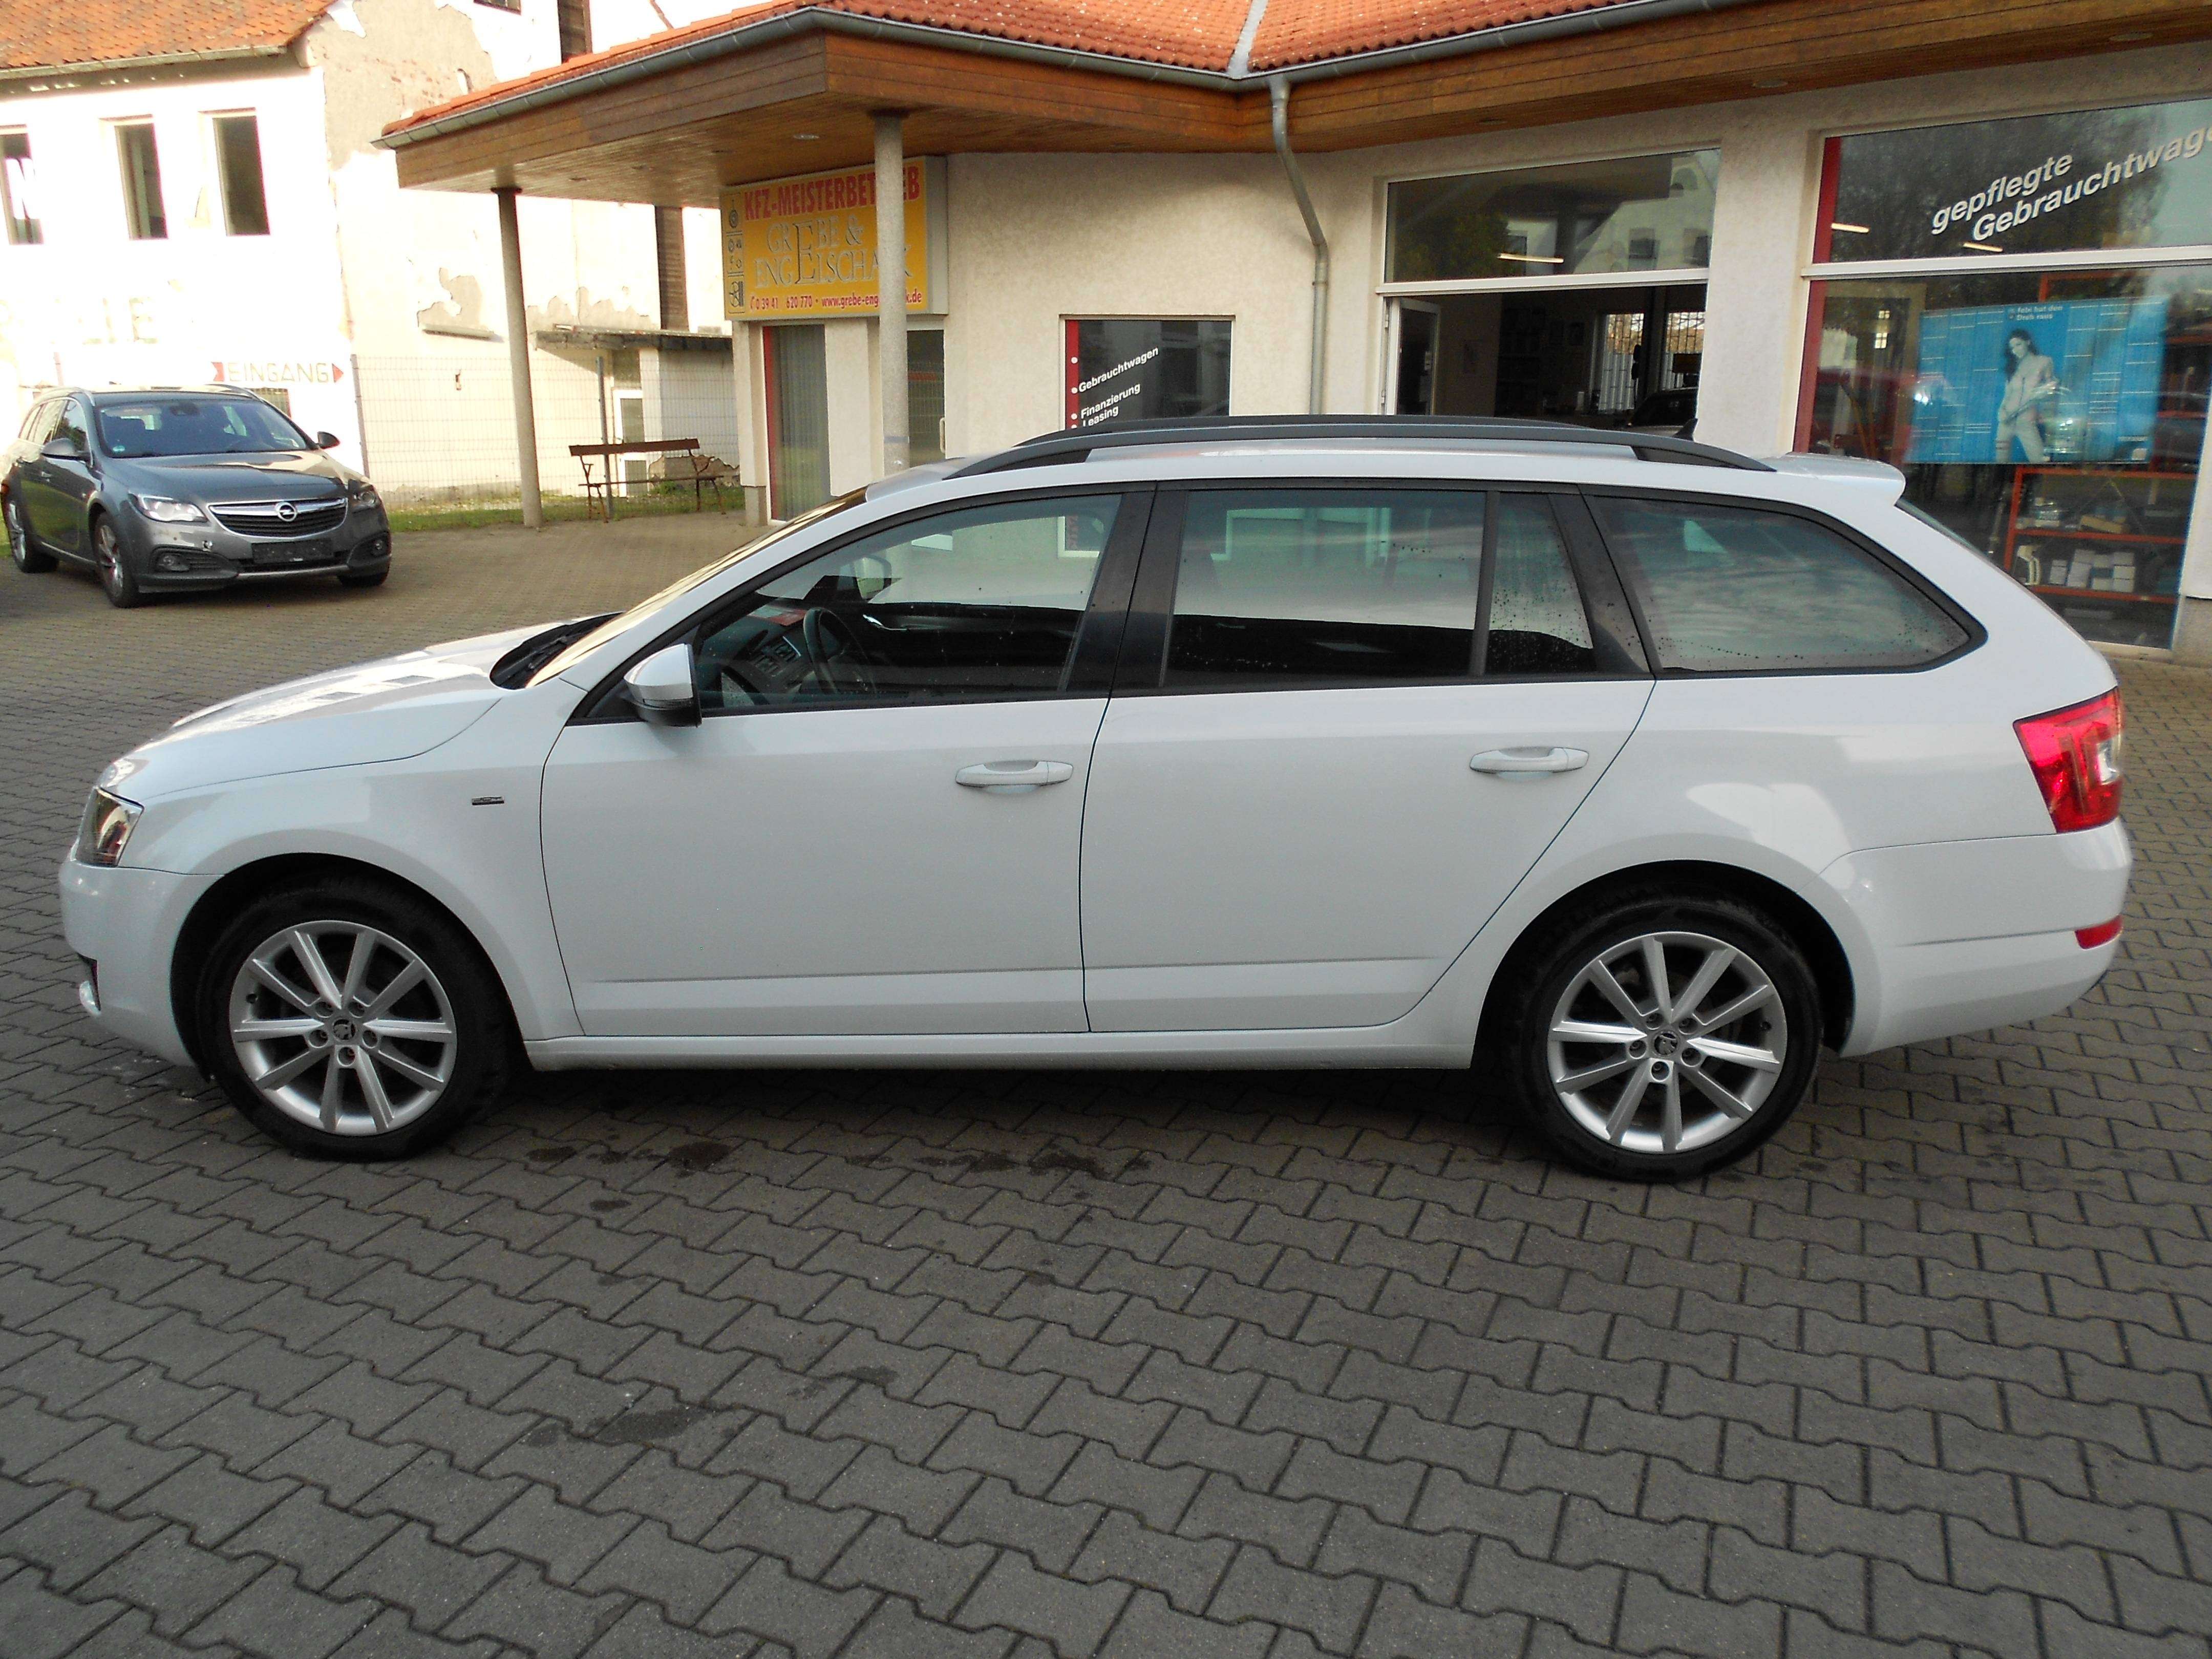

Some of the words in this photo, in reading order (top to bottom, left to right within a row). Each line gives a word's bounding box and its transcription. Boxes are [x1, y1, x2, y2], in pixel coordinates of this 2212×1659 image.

[744, 166, 921, 220] KFZ-MEISTERBETB
[1931, 155, 2073, 235] gepflegte
[1973, 126, 2212, 241] Gebrauchtwag
[767, 215, 840, 255] GREBE
[845, 214, 864, 246] &
[755, 244, 912, 289] ENGELSCHA
[800, 295, 813, 308] 770
[821, 288, 922, 309] www.grebe-engk.de
[227, 362, 329, 382] EINGANG
[1078, 347, 1159, 393] Gebrauchtwagen
[1080, 383, 1141, 419] Finanzierung
